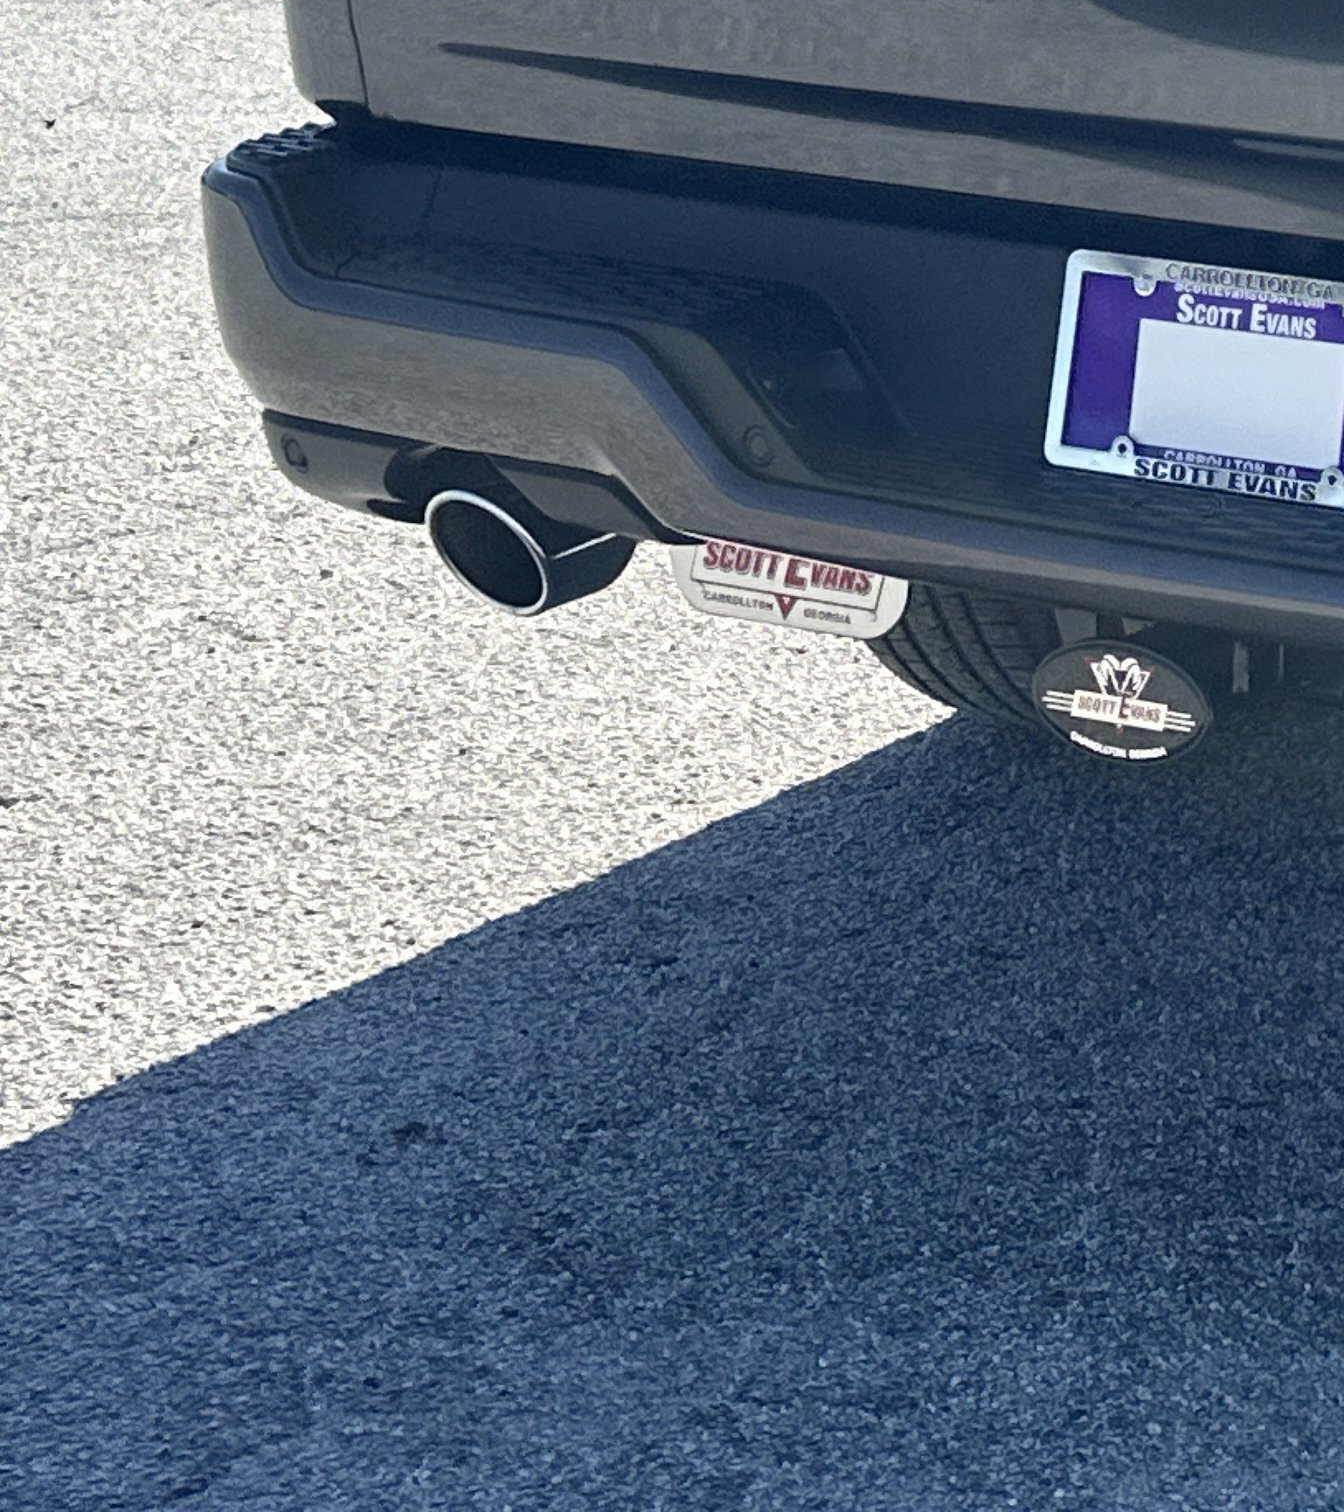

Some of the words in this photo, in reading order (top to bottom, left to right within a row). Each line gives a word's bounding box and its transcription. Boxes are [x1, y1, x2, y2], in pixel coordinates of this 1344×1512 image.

[1306, 281, 1334, 300] GA
[1134, 458, 1218, 486] SCOTT
[1227, 472, 1317, 501] EVANS
[703, 541, 782, 581] SCOTT
[783, 557, 875, 596] EVANS
[803, 607, 851, 625] GEORGIA
[1078, 694, 1117, 716] SCOTT
[1117, 692, 1161, 723] EVANS
